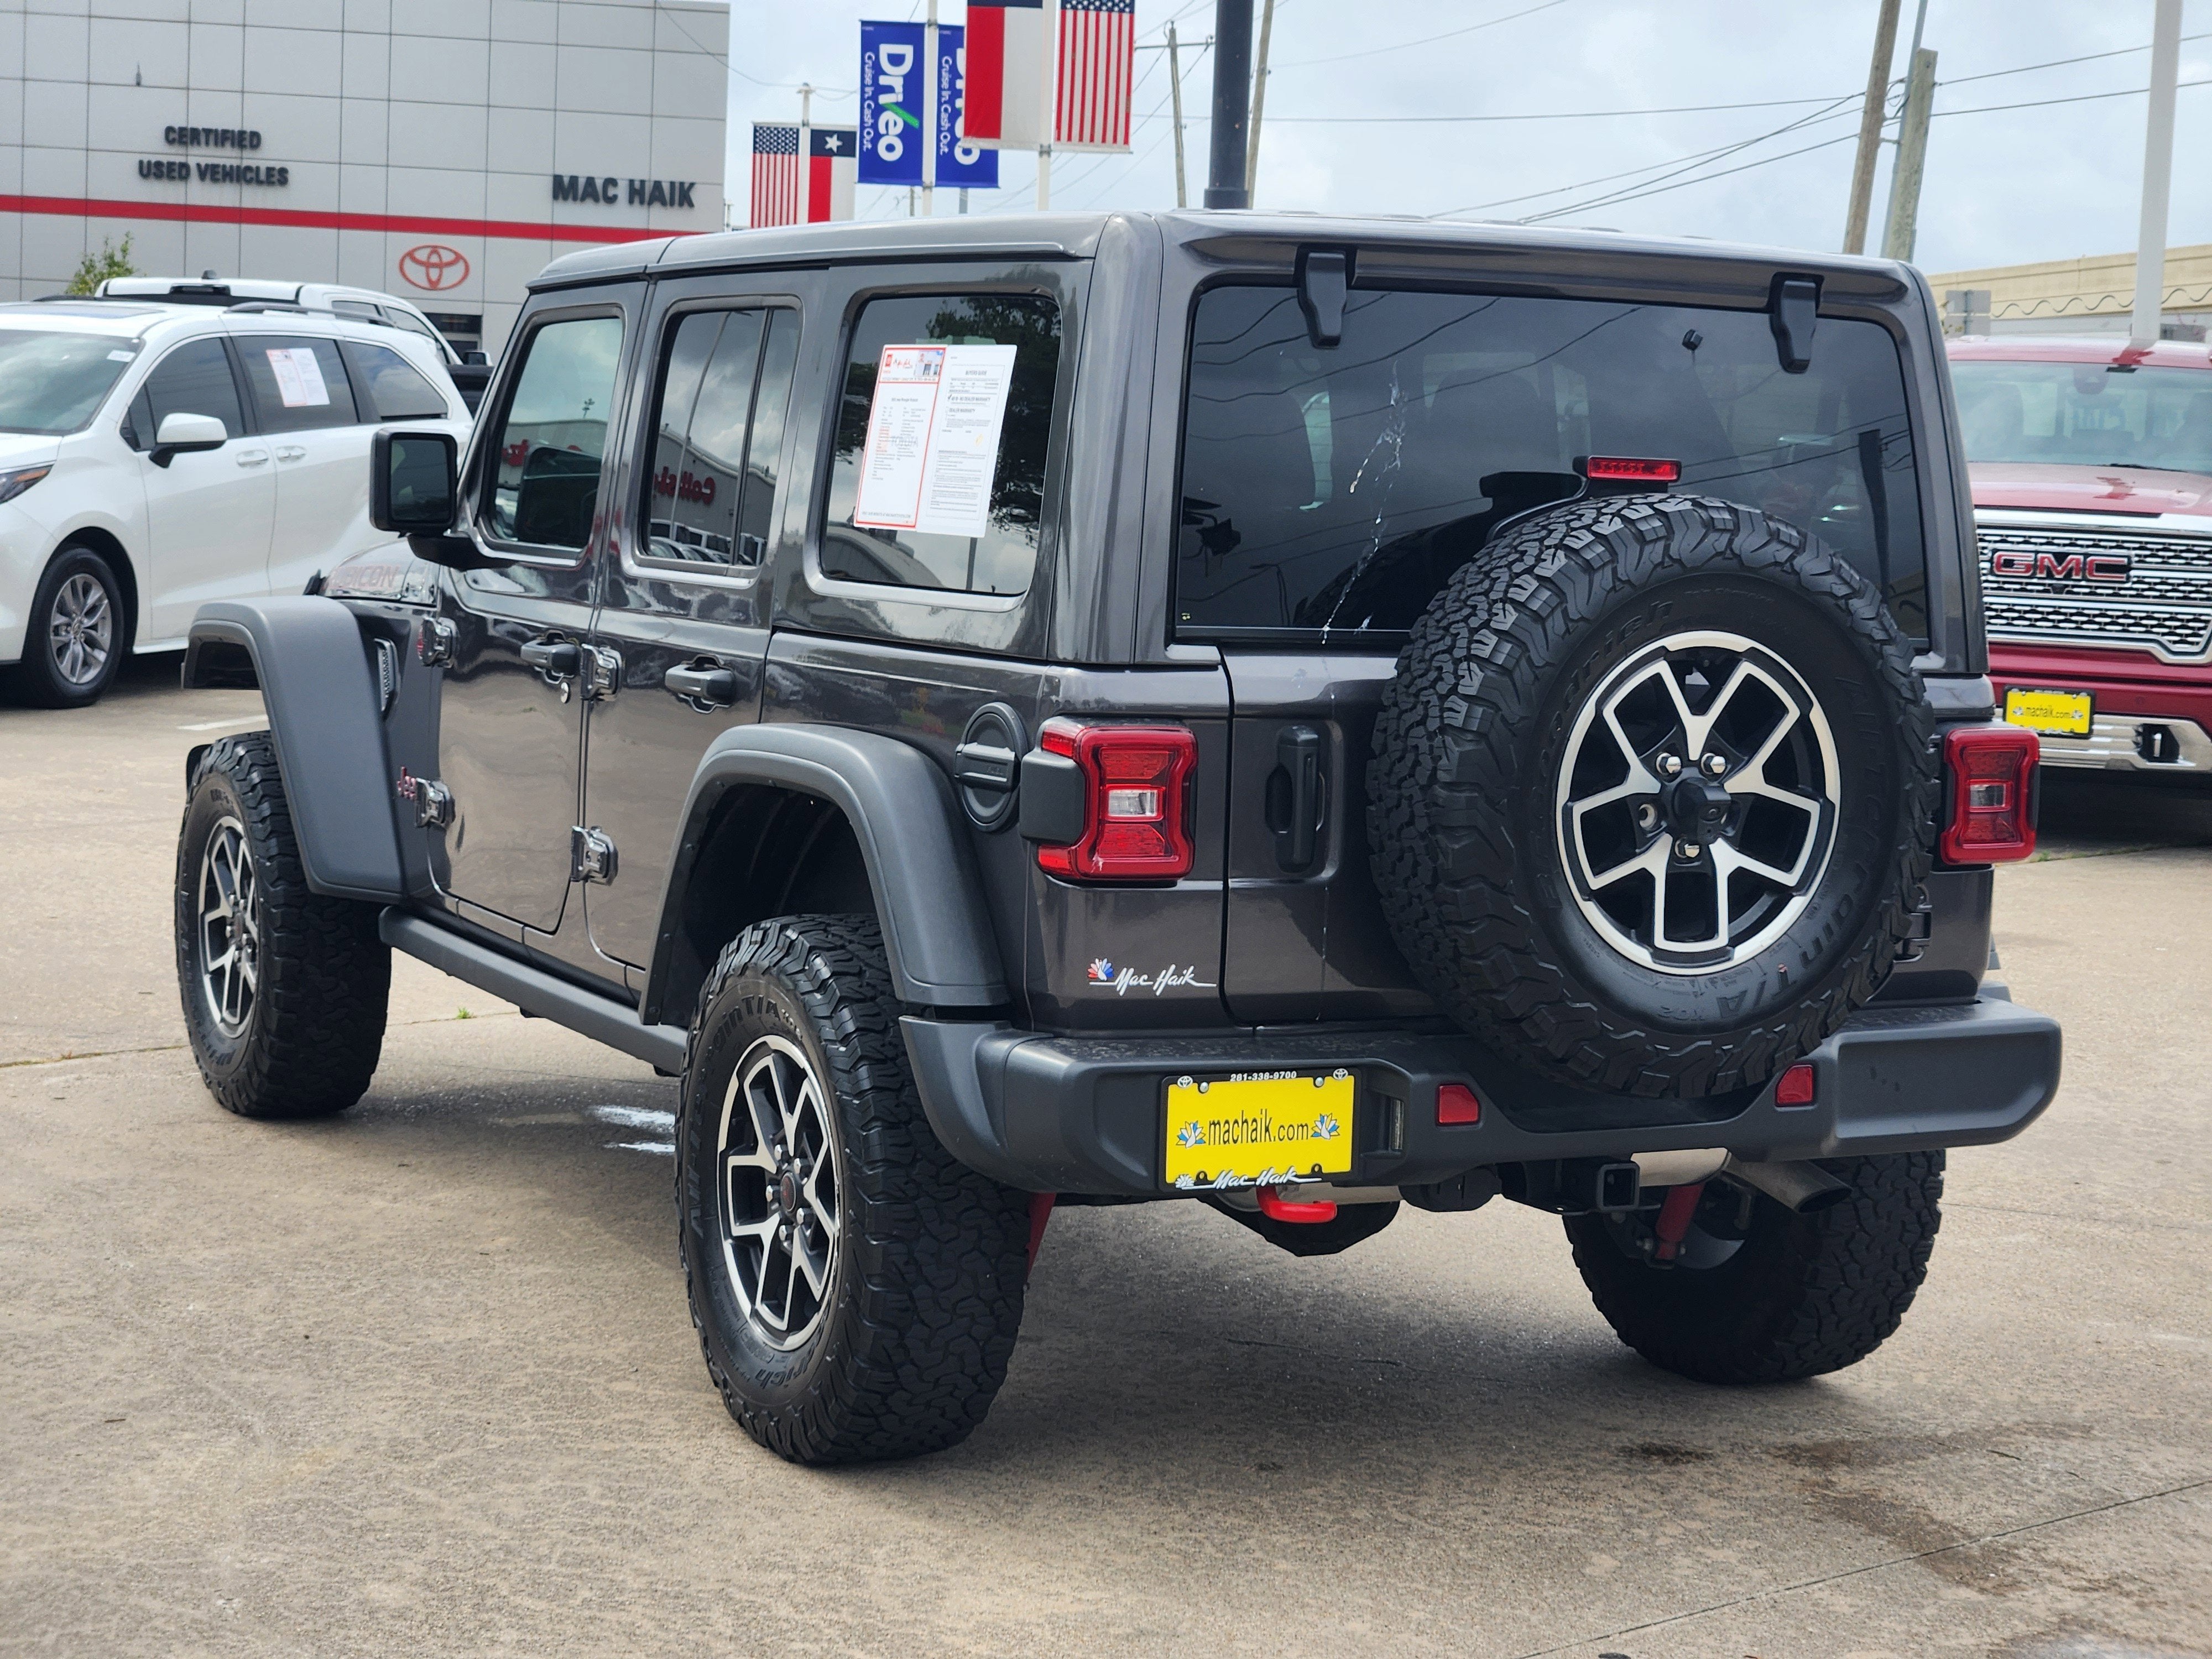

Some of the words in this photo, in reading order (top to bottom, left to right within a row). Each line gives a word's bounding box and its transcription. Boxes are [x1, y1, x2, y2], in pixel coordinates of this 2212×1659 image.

[863, 51, 875, 86] Cruise
[941, 55, 952, 90] Cruise
[863, 100, 874, 127] Cash
[940, 104, 951, 131] Cash
[164, 126, 262, 150] CERTIFIED
[138, 159, 191, 181] USED
[195, 163, 289, 186] VEHICLES
[552, 174, 618, 205] MAC
[628, 179, 696, 208] HAIK
[1993, 551, 2128, 582] GMC
[1109, 967, 1154, 996] Mac
[1152, 963, 1204, 996] Haik
[1208, 1108, 1309, 1146] machaik.com
[1207, 1170, 1255, 1190] Mac
[1256, 1166, 1303, 1187] Haik
